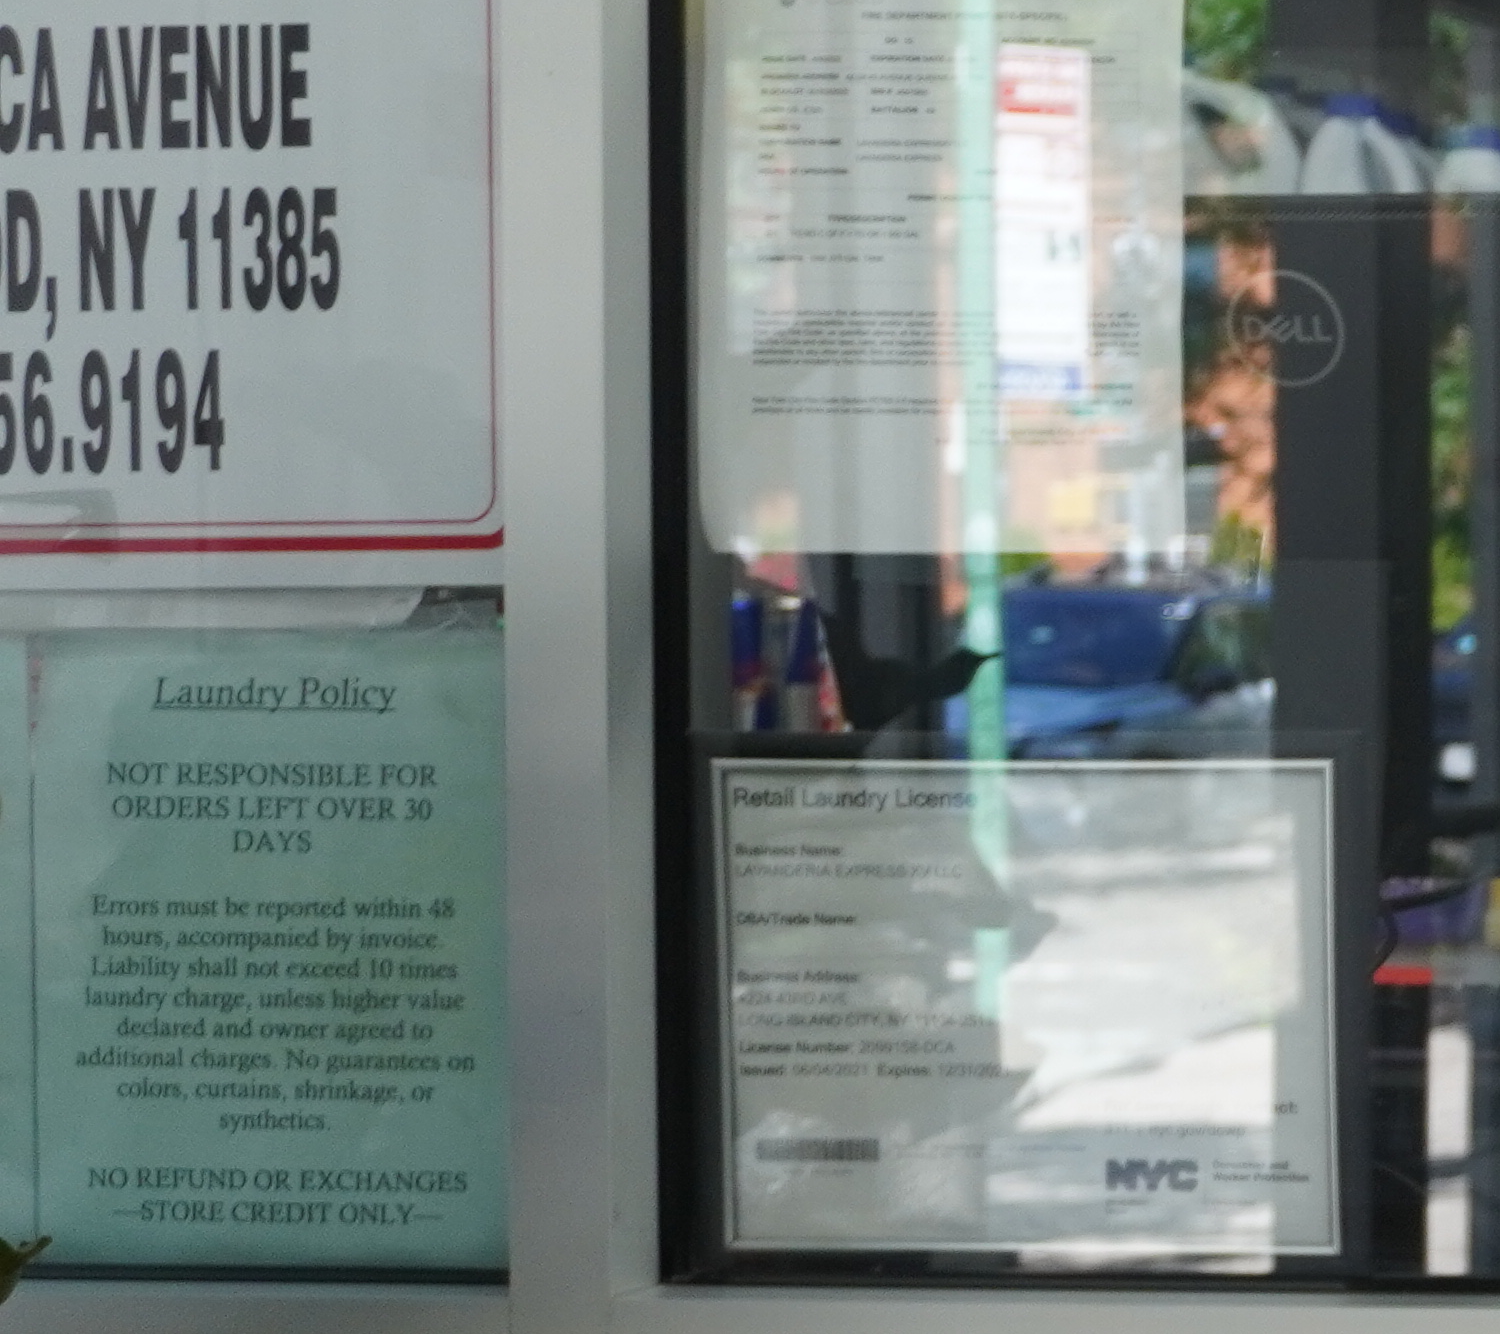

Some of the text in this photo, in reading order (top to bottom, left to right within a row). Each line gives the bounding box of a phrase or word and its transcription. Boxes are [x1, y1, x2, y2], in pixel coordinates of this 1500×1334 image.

[83, 23, 312, 152] AVENUE
[78, 188, 156, 312] NY
[178, 186, 341, 312] 11385
[1242, 314, 1332, 343] DELL
[153, 675, 397, 713] Laundry Policy
[106, 761, 438, 789] NOT RESPONSIBLE FOR
[110, 794, 434, 823] ORDERS LEFT OVER 30
[732, 786, 795, 809] Retail
[802, 787, 888, 814] Laundry
[232, 828, 313, 855] DAYS
[90, 892, 160, 918] Errors
[165, 899, 219, 918] must
[223, 895, 251, 918] be
[255, 896, 347, 920] reported
[352, 896, 423, 920] within
[101, 924, 171, 951] hours,
[175, 926, 321, 953] accompanied
[325, 926, 354, 953] by
[90, 954, 181, 983] Liability
[186, 955, 239, 980] shall
[243, 960, 280, 980] not
[284, 956, 361, 980] exceed
[369, 957, 395, 981] 10
[84, 985, 466, 1014] laundry charge, unless higher value
[115, 1015, 435, 1044] declared and owner agreed to
[74, 1045, 185, 1069] additional
[284, 1047, 321, 1071] No
[324, 1053, 442, 1076] guarantees
[445, 1055, 476, 1073] on
[115, 1076, 189, 1102] colors,
[193, 1078, 288, 1103] curtains,
[409, 1085, 436, 1103] or
[87, 1166, 469, 1194] NO REFUND OR EXCHANGES
[1105, 1158, 1199, 1193] NYC
[229, 1200, 333, 1225] CREDIT
